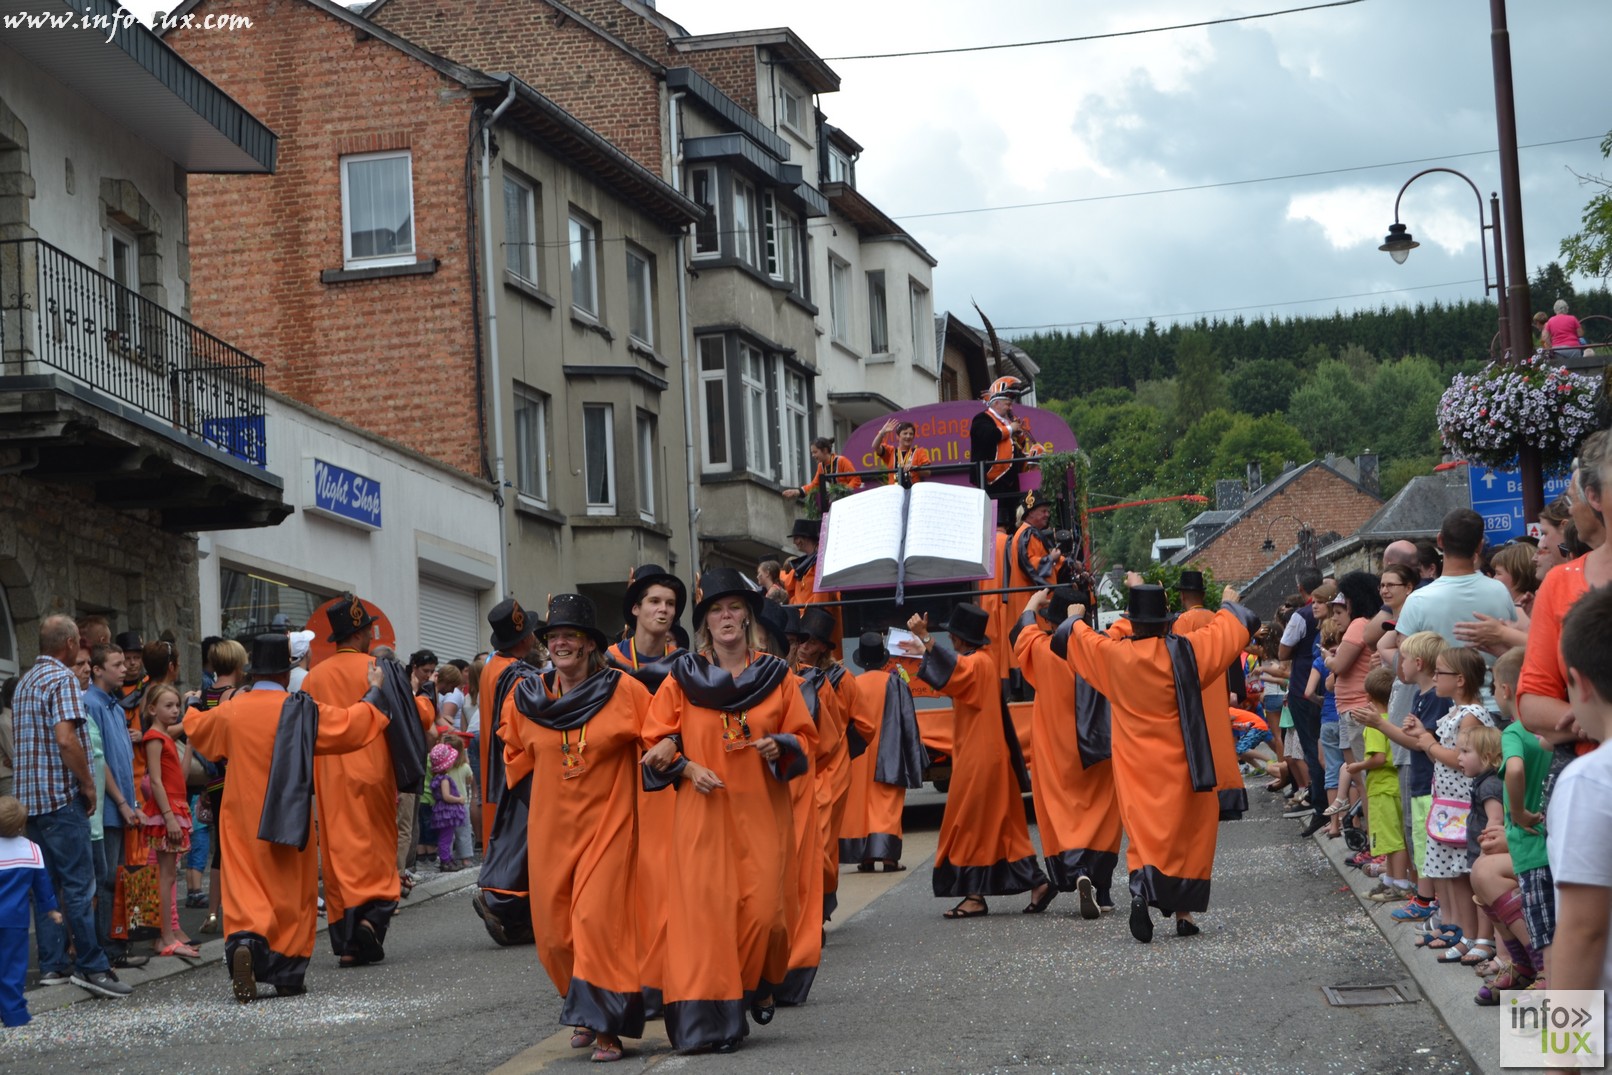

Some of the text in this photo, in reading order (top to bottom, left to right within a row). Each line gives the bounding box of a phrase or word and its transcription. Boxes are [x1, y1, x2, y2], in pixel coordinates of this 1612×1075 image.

[315, 462, 380, 521] Night Shop
[1507, 478, 1571, 493] Bagne
